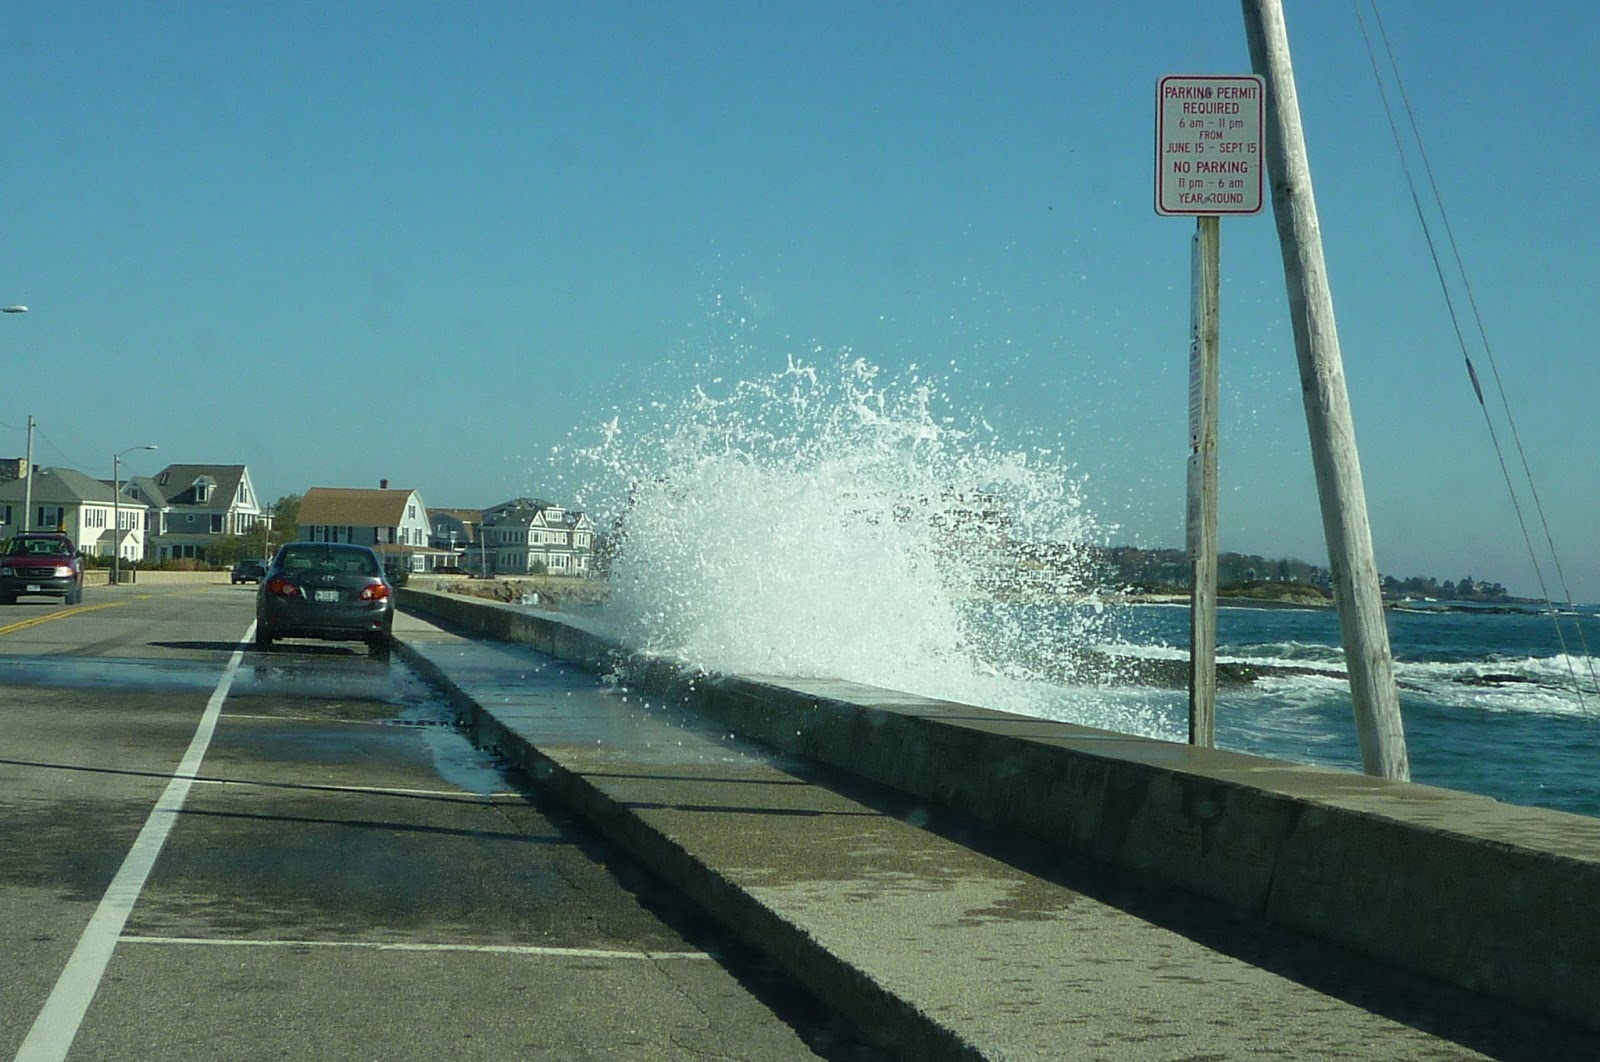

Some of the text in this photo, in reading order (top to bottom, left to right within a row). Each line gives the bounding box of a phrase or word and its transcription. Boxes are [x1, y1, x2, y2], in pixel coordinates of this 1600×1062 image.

[1165, 87, 1257, 99] PARKING PERMIT
[1183, 102, 1239, 114] REQUIRED
[1179, 118, 1185, 128] 6
[1189, 120, 1204, 128] am
[1219, 118, 1225, 128] 11
[1229, 120, 1243, 130] pm
[1199, 131, 1223, 140] FROM
[1166, 143, 1190, 153] JUNE
[1195, 143, 1204, 153] 15
[1219, 143, 1243, 153] SEPT
[1247, 143, 1257, 153] 15
[1173, 161, 1248, 173] NO PARKING
[1189, 180, 1203, 190] pm
[1218, 178, 1224, 188] 6
[1229, 180, 1243, 188] am
